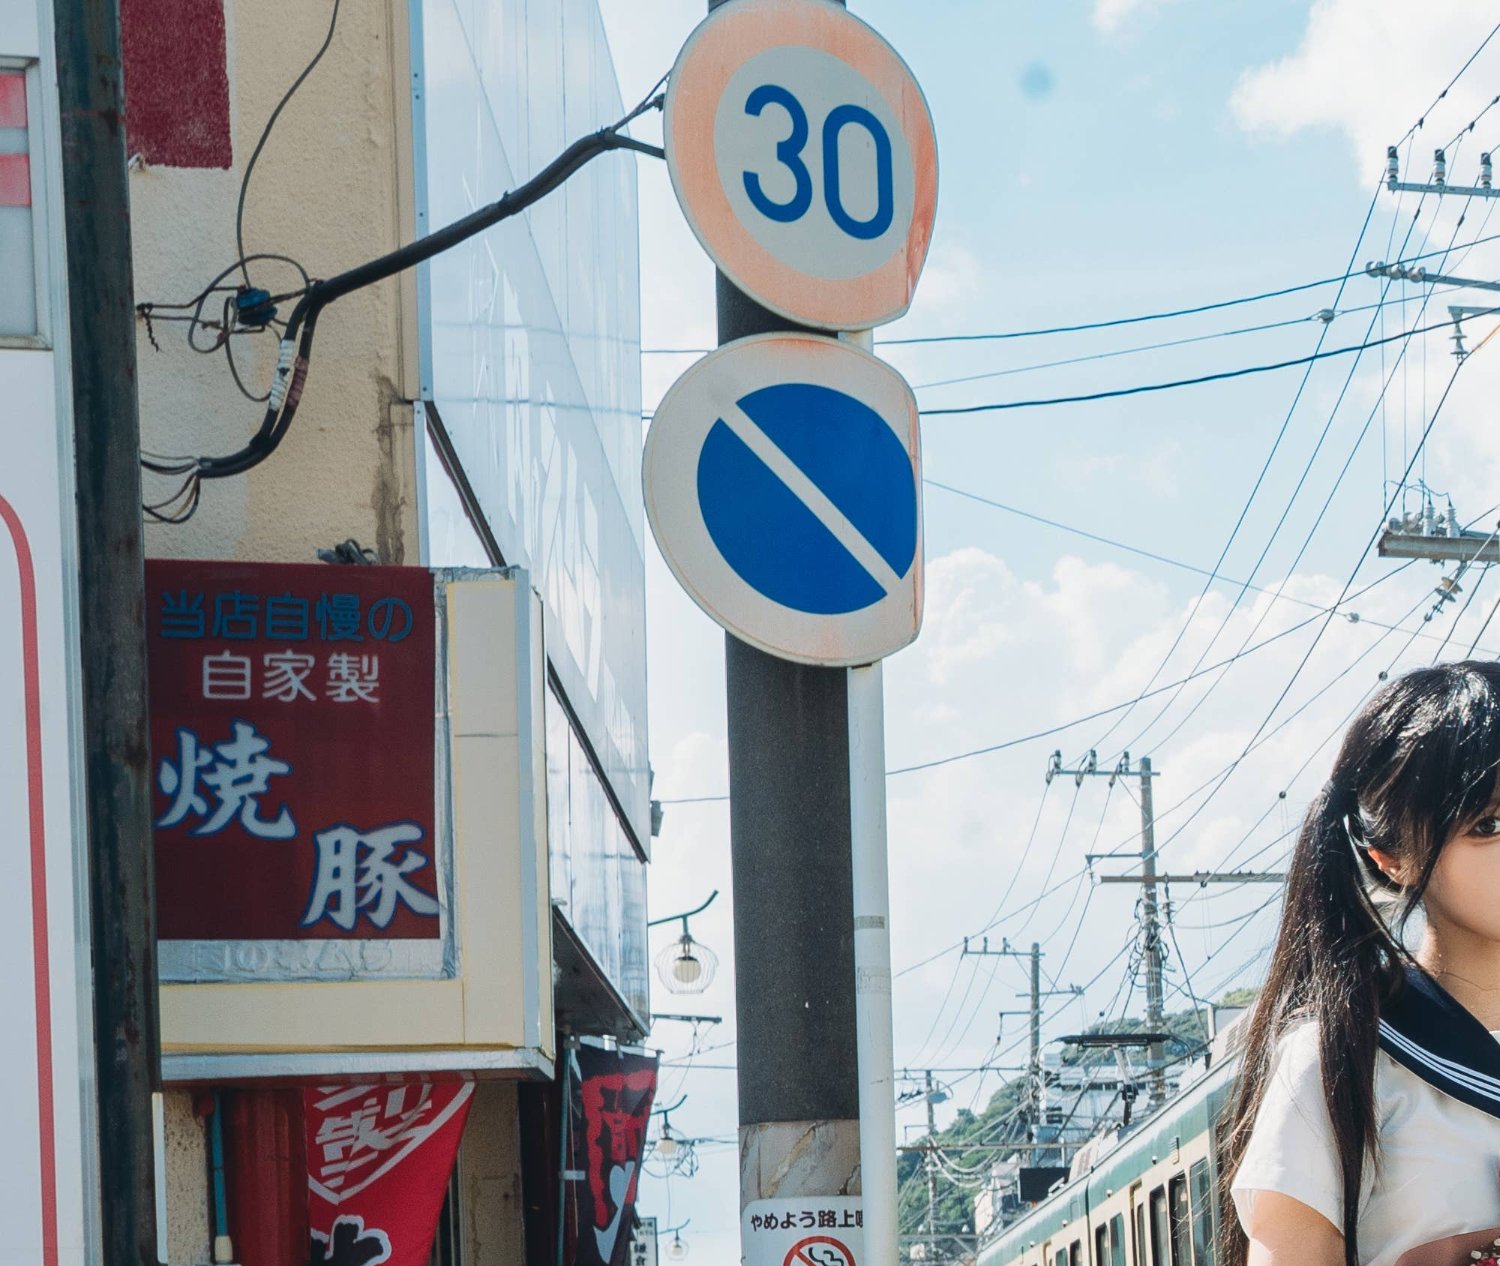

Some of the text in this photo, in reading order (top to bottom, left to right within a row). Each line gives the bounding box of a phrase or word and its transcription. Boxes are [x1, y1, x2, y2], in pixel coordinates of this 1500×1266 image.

[743, 84, 894, 240] 30
[160, 589, 413, 642] 当店自慢の
[202, 649, 381, 704] 自家製
[154, 717, 441, 931] 焼豚
